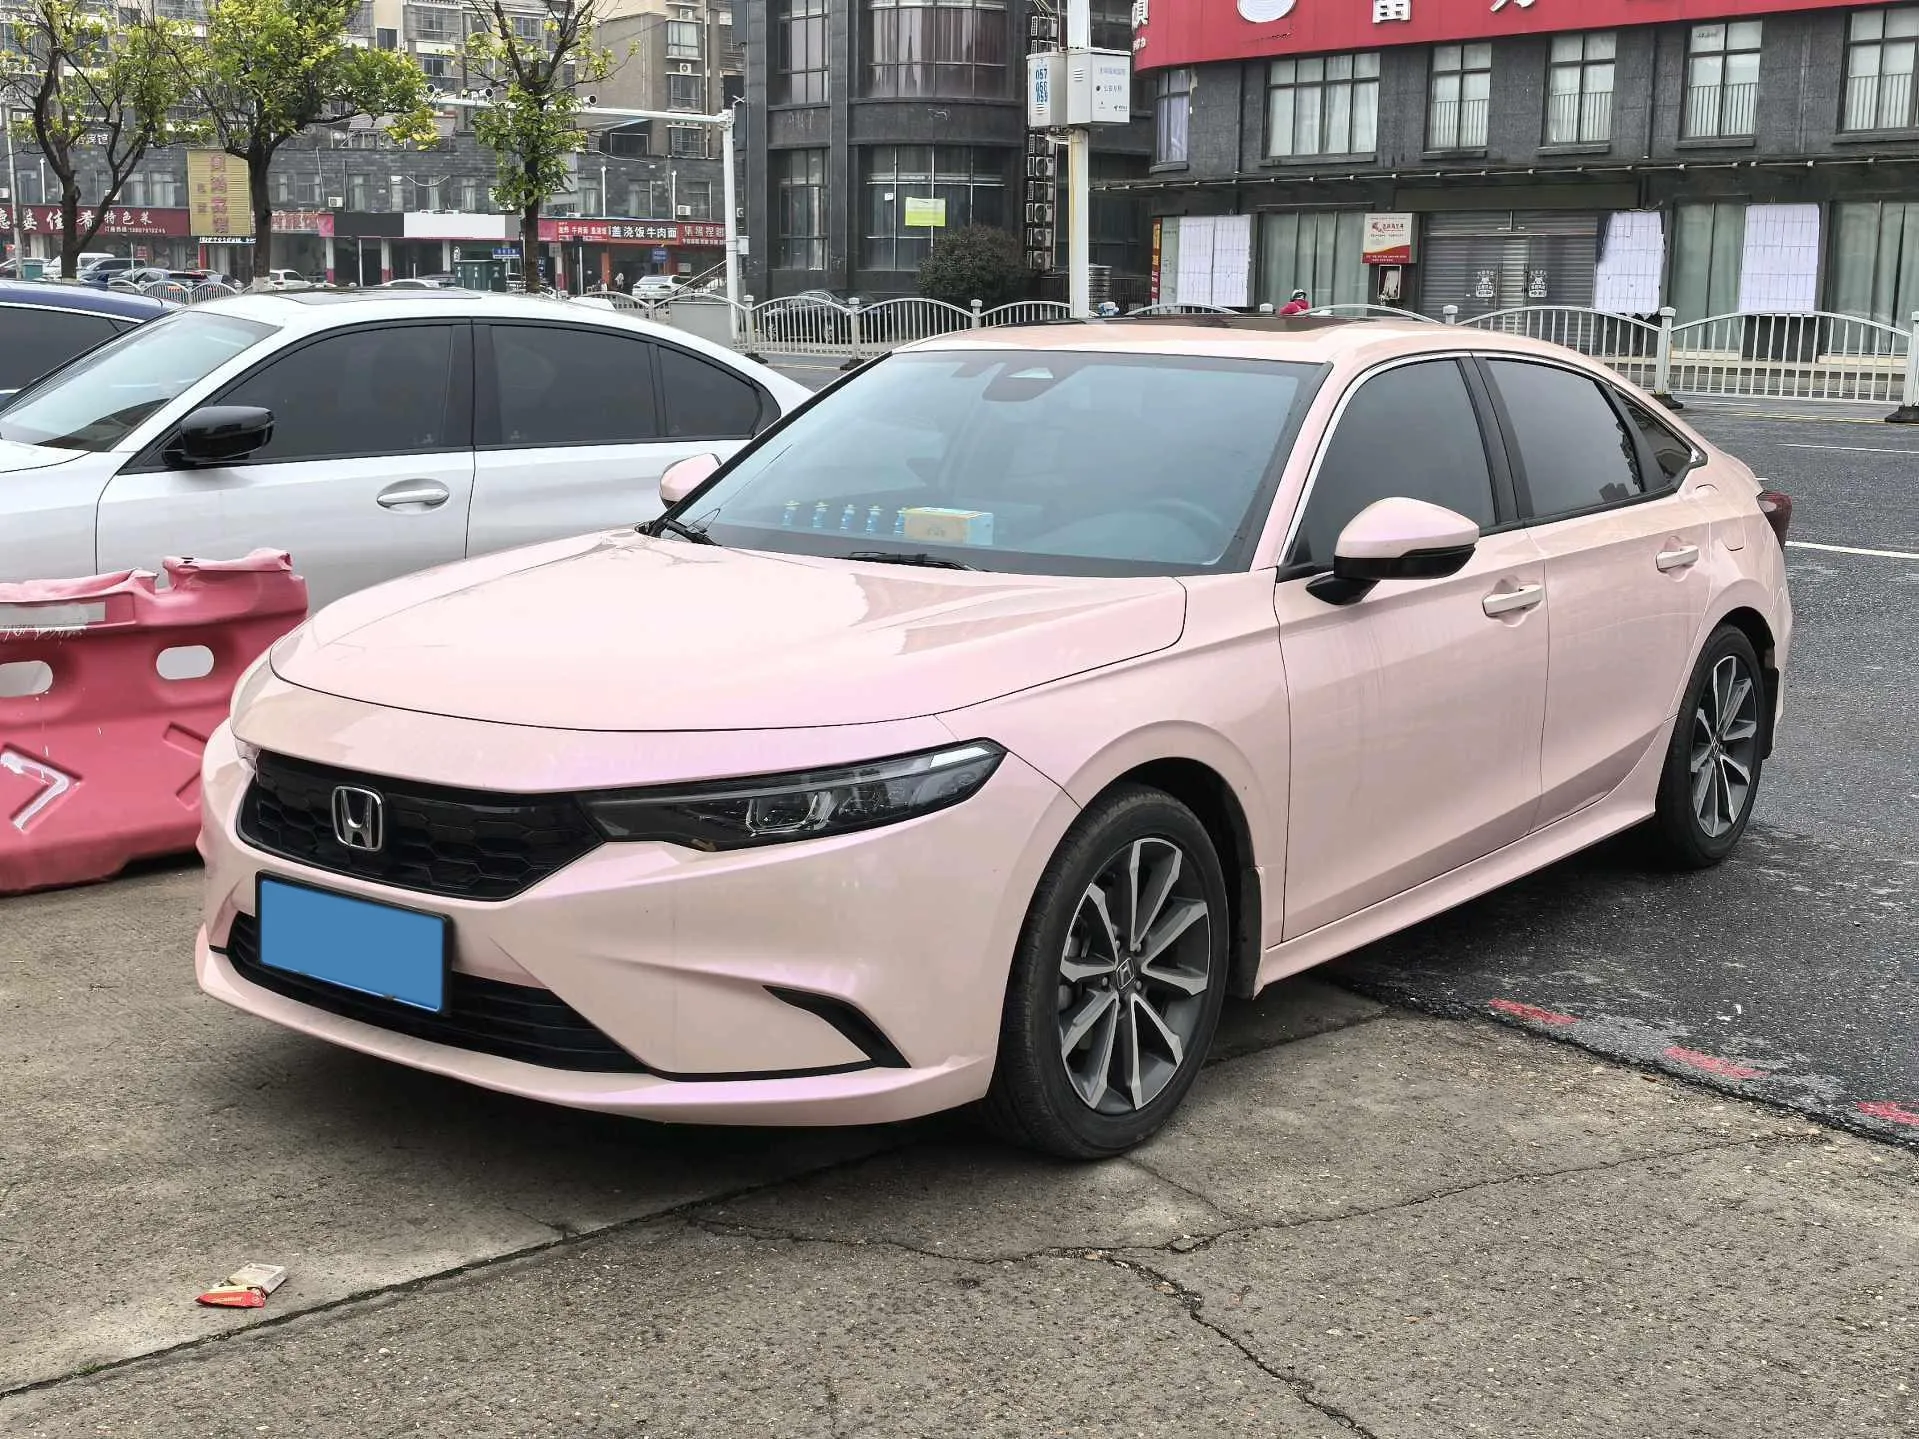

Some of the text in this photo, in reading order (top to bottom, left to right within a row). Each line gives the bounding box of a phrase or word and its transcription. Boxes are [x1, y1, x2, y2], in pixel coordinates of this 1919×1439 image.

[1035, 68, 1048, 80] 057
[103, 211, 154, 226] 特色菜
[611, 224, 678, 239] 盖浇饭牛肉面
